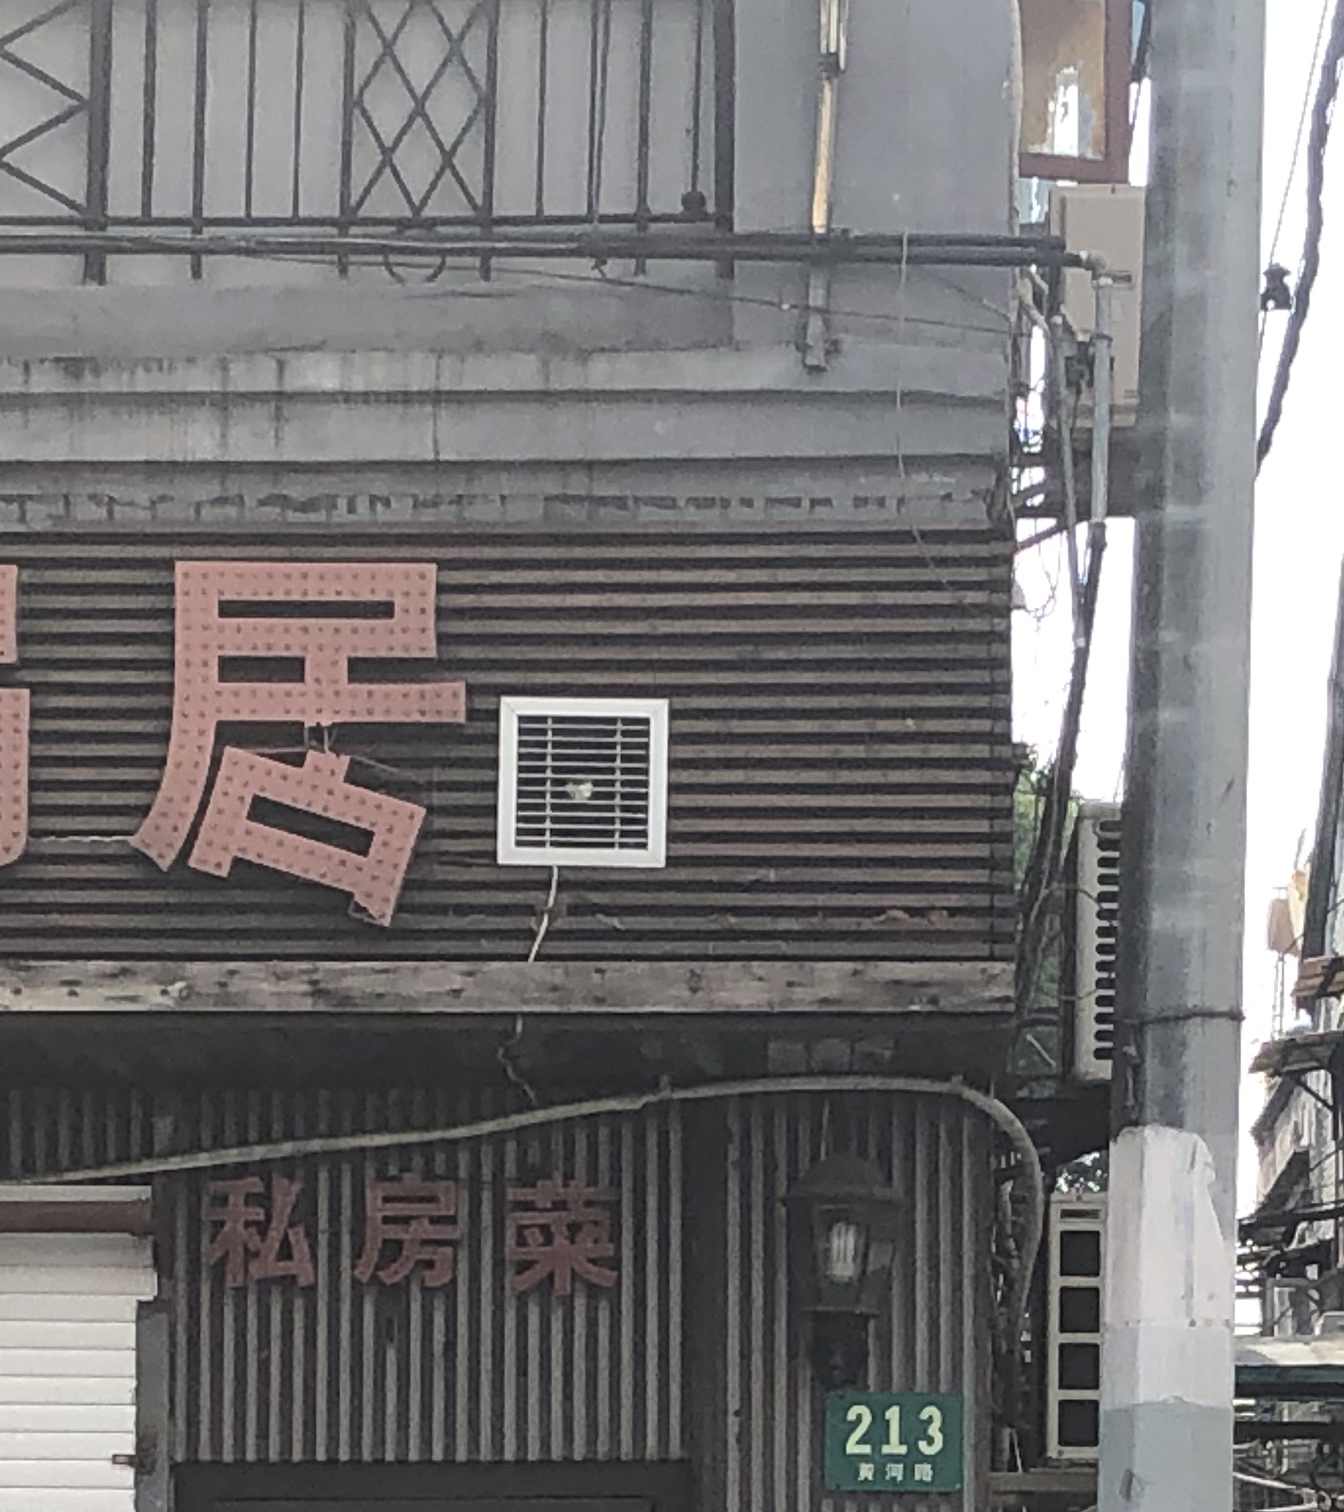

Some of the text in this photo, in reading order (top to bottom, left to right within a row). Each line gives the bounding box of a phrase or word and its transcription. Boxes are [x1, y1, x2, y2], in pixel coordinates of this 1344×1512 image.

[204, 1172, 621, 1299] 私房菜
[845, 1404, 944, 1456] 213
[857, 1462, 934, 1484] 黄河路
